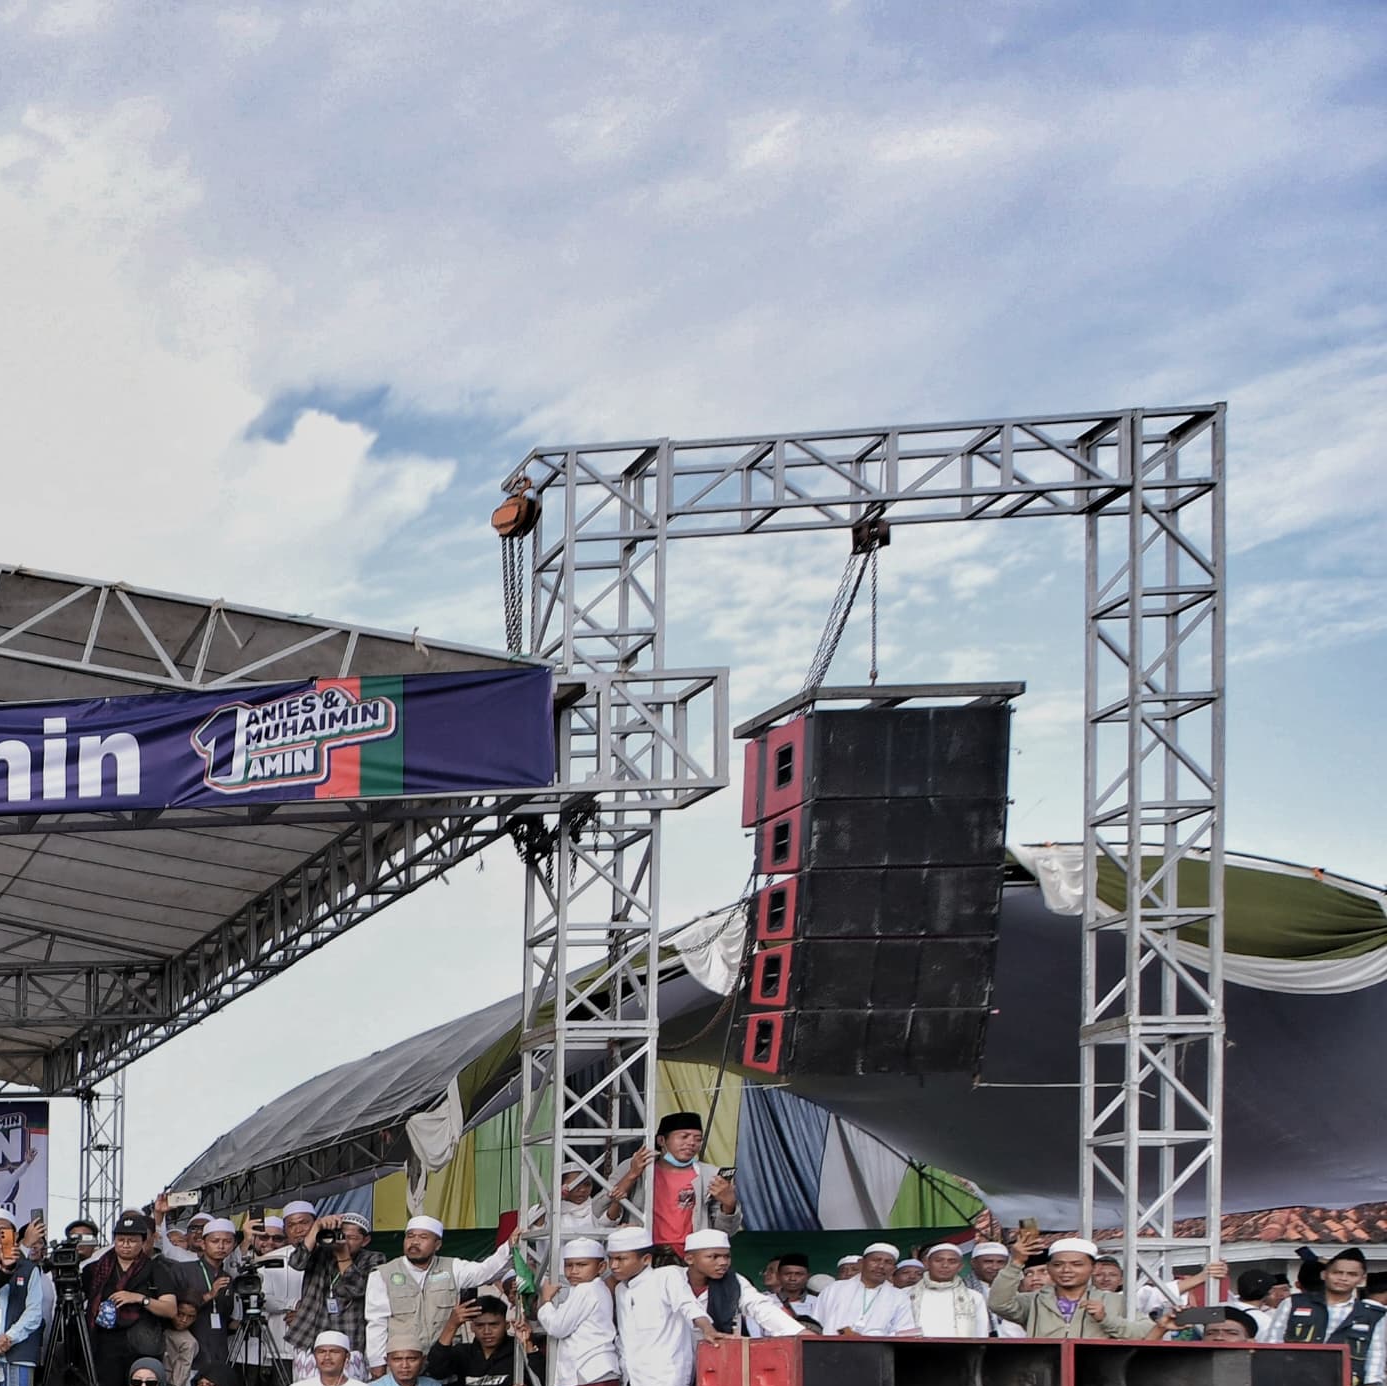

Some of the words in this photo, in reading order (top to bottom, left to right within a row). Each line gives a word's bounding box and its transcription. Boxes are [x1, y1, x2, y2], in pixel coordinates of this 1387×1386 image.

[245, 694, 317, 728] ANIES
[322, 690, 341, 710] &
[245, 701, 380, 746] MUHAIMIN
[248, 748, 316, 780] AMIN
